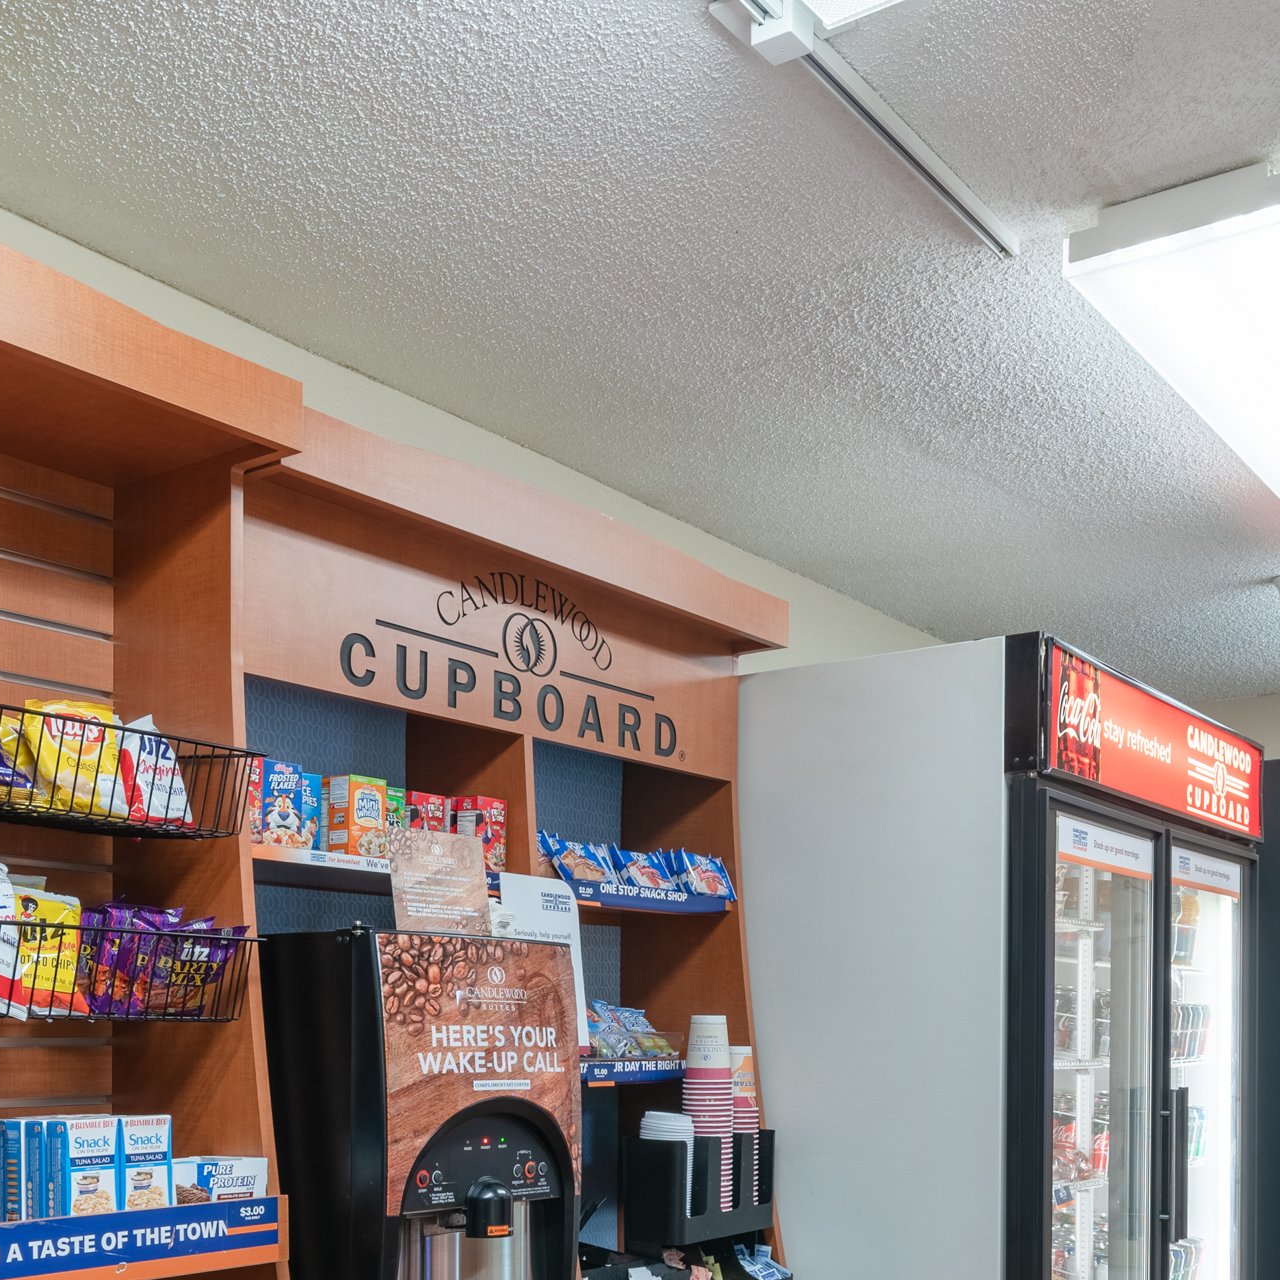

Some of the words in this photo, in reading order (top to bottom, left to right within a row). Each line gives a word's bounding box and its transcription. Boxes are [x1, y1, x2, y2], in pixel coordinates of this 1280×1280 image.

[437, 572, 612, 671] CANDLEWOOD
[340, 632, 677, 758] CUPBOARD
[1058, 681, 1101, 748] Coca-Cola
[1104, 719, 1124, 748] stay
[1127, 727, 1171, 764] refreshed
[1186, 725, 1252, 774] CANDLEWOOD
[269, 774, 299, 782] FROSTED
[270, 781, 296, 790] FLAKES
[358, 799, 378, 810] Mini
[1186, 784, 1250, 825] CUPBOARD
[366, 858, 389, 869] We've
[600, 883, 617, 894] ONE
[618, 885, 639, 897] STOP
[640, 887, 666, 900] SNACK
[667, 890, 688, 902] SHOP
[514, 928, 538, 940] Seriously,
[539, 931, 551, 941] help
[180, 944, 210, 961] utz
[466, 986, 527, 999] CANDLEWOOD
[481, 1003, 516, 1012] SUITES
[431, 1025, 506, 1048] HERE'S
[509, 1025, 556, 1048] YOUR
[418, 1051, 518, 1074] WAKE-UP
[523, 1051, 565, 1073] CALL.
[624, 1062, 641, 1073] DAY
[642, 1061, 656, 1072] THE
[658, 1060, 680, 1071] RIGHT
[75, 1119, 100, 1130] BUMBLE
[102, 1119, 114, 1129] BEE
[129, 1118, 154, 1127] BUMBLE
[155, 1117, 168, 1126] BEE
[73, 1135, 111, 1150] Snack
[128, 1132, 162, 1147] Snack
[74, 1157, 91, 1166] TUNA
[92, 1156, 111, 1165] SALAD
[129, 1154, 146, 1163] TUNA
[146, 1153, 163, 1162] SALAD
[203, 1163, 234, 1176] PURE
[209, 1175, 256, 1189] PROTEIN
[239, 1205, 265, 1217] $3.00
[7, 1243, 23, 1262] A
[28, 1234, 96, 1259] TASTE
[101, 1230, 128, 1250] OF
[133, 1225, 172, 1247] THE
[175, 1219, 228, 1241] TOWN
